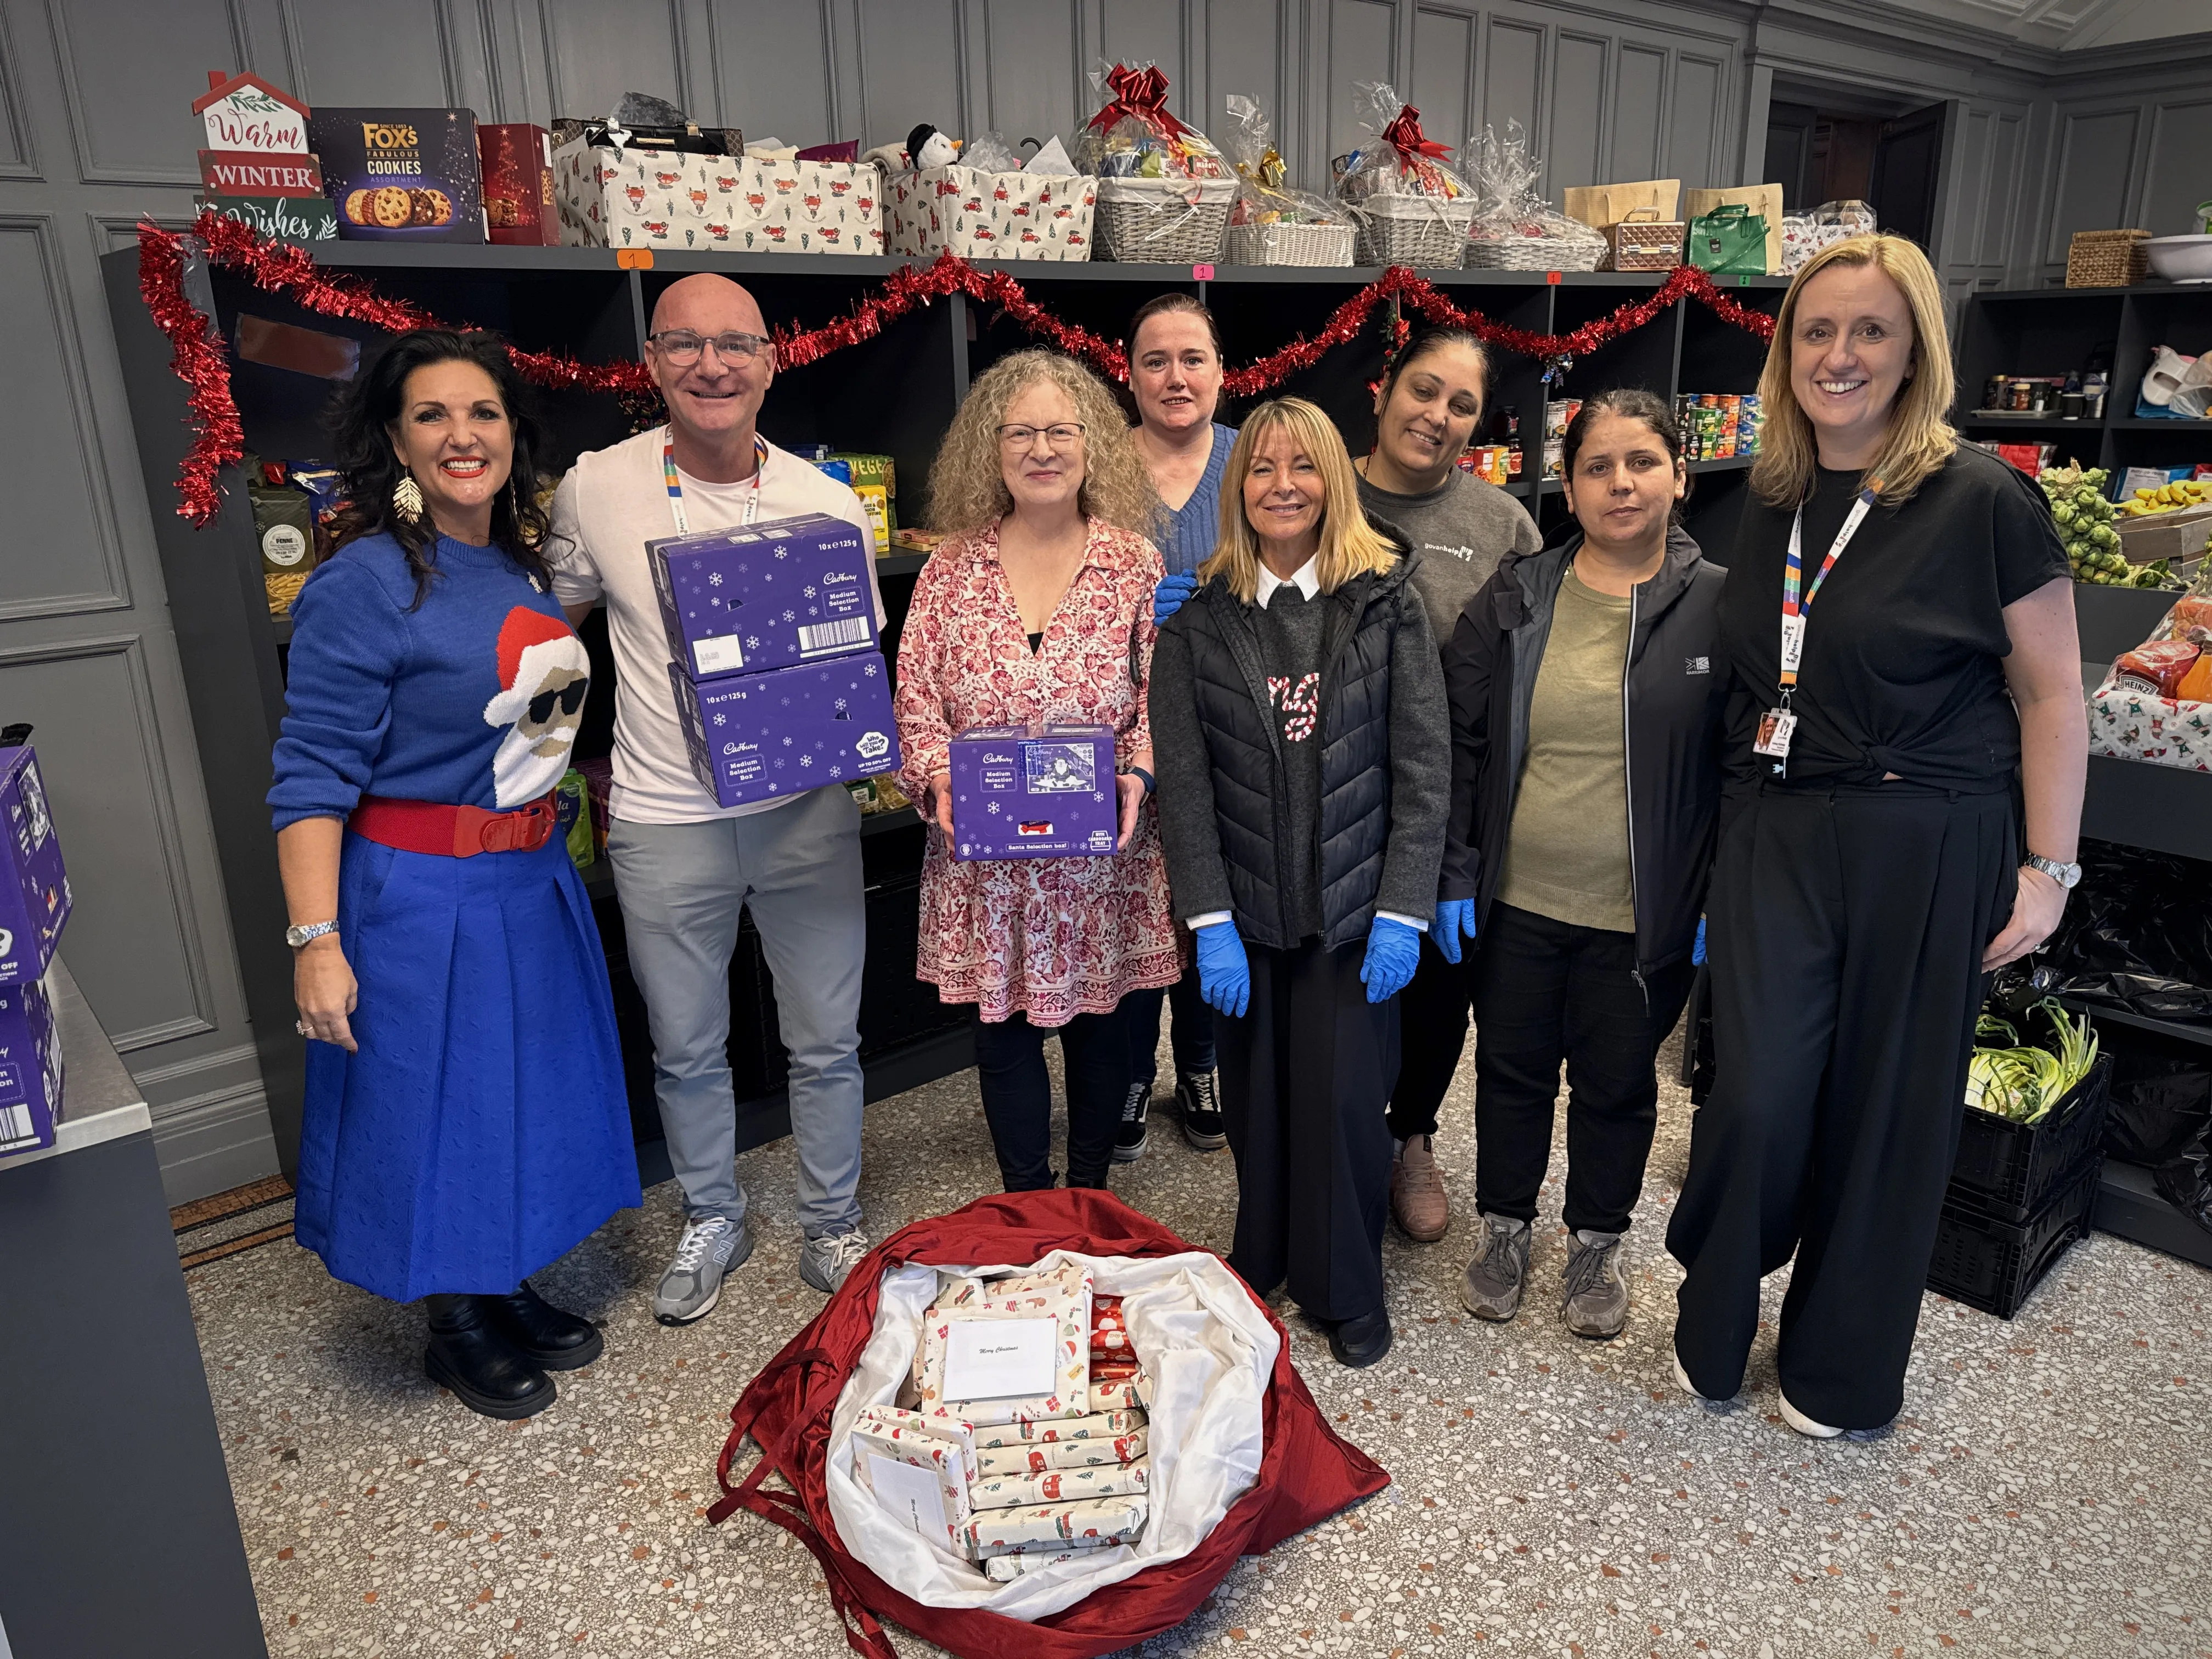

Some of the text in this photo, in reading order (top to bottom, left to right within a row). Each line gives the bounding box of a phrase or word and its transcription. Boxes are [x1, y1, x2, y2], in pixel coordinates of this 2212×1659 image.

[207, 108, 303, 150] Warm
[367, 161, 422, 174] COOKIES
[212, 165, 315, 189] WINTER
[224, 197, 312, 239] Wishes
[629, 253, 639, 269] 1
[1199, 267, 1206, 278] 1
[1551, 274, 1555, 283] 1
[1425, 543, 1459, 556] govanhelp
[823, 572, 857, 585] Cadbury
[828, 597, 859, 607] Selection
[830, 591, 856, 600] Medium
[2125, 681, 2149, 694] HEINZ
[723, 742, 758, 755] Cadbury
[730, 759, 758, 769] Medium
[983, 753, 1013, 764] Cadbury
[729, 765, 761, 776] Selection
[1, 962, 18, 970] OFF
